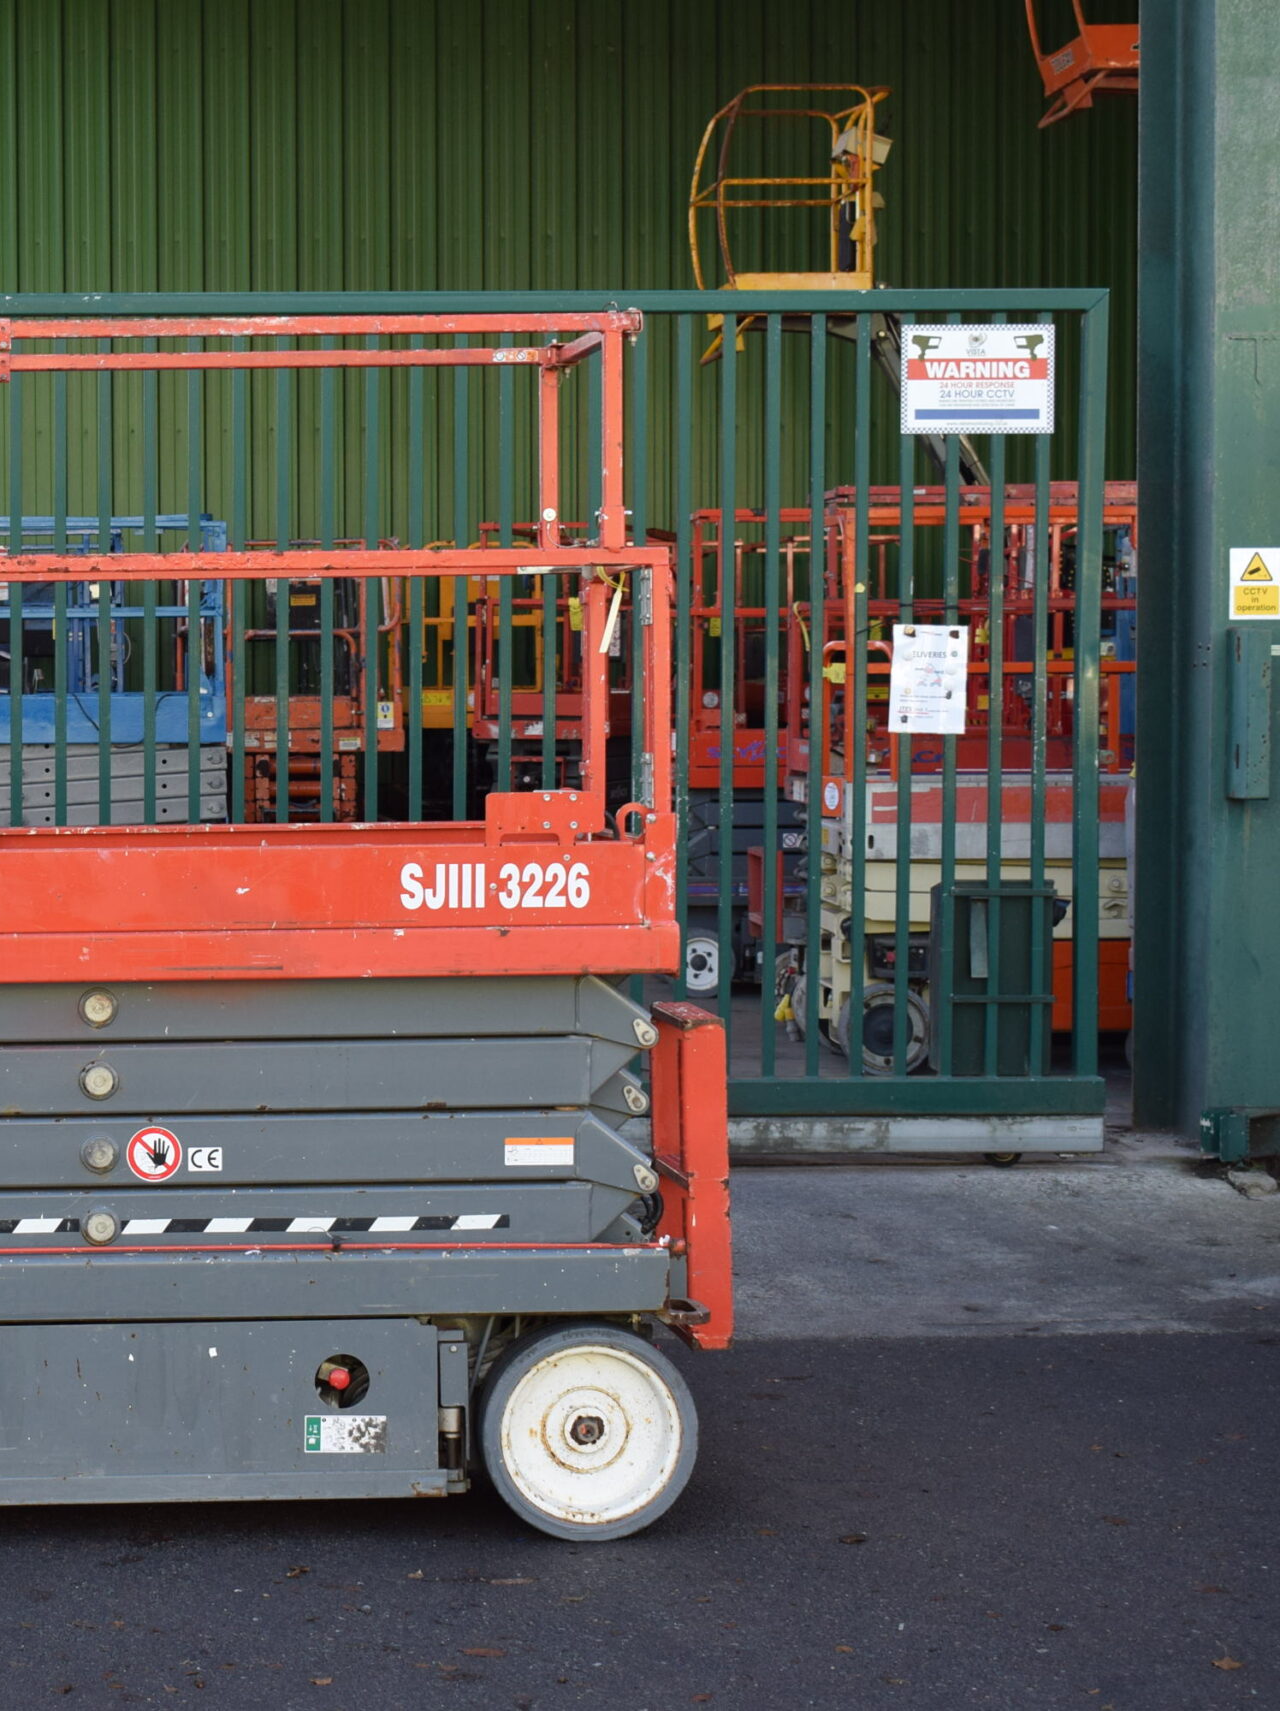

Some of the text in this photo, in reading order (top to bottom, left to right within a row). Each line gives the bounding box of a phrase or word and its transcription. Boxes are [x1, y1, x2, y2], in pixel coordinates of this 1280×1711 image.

[924, 361, 1030, 379] WARNING
[940, 389, 1015, 398] 24 HOUR CCTV
[1242, 587, 1268, 595] CCTV
[1236, 604, 1276, 612] operation
[400, 862, 590, 910] SJIII 3226
[191, 1149, 219, 1168] CE
